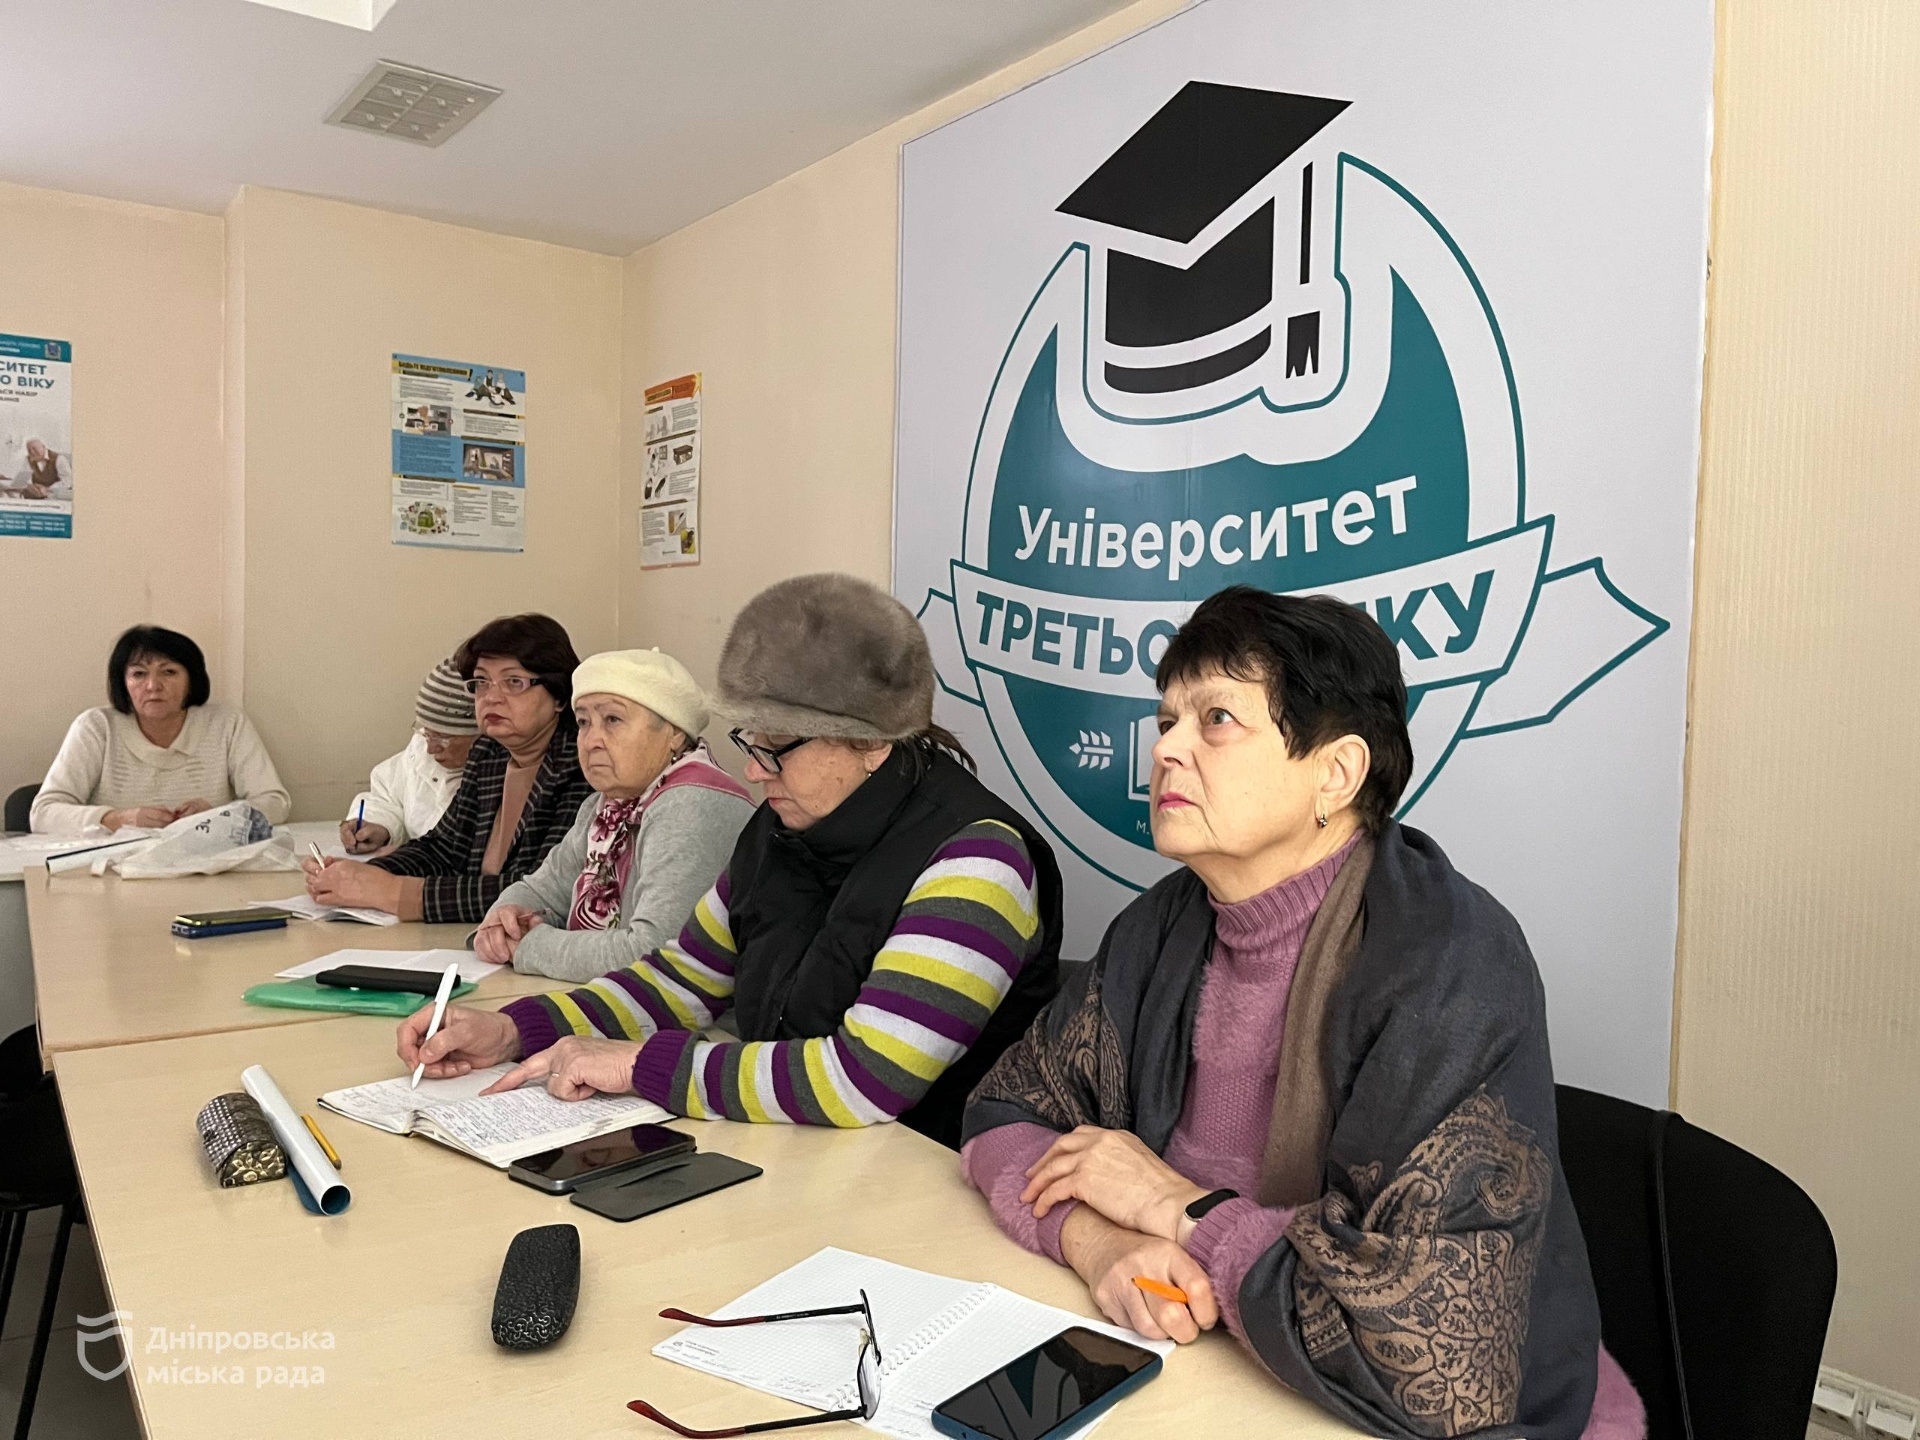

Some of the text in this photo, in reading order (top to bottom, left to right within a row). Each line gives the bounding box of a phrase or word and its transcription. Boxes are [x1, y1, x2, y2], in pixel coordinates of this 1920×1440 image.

[18, 376, 55, 389] ВІКУ
[1015, 475, 1417, 580] Університет
[1354, 569, 1495, 660] КУ
